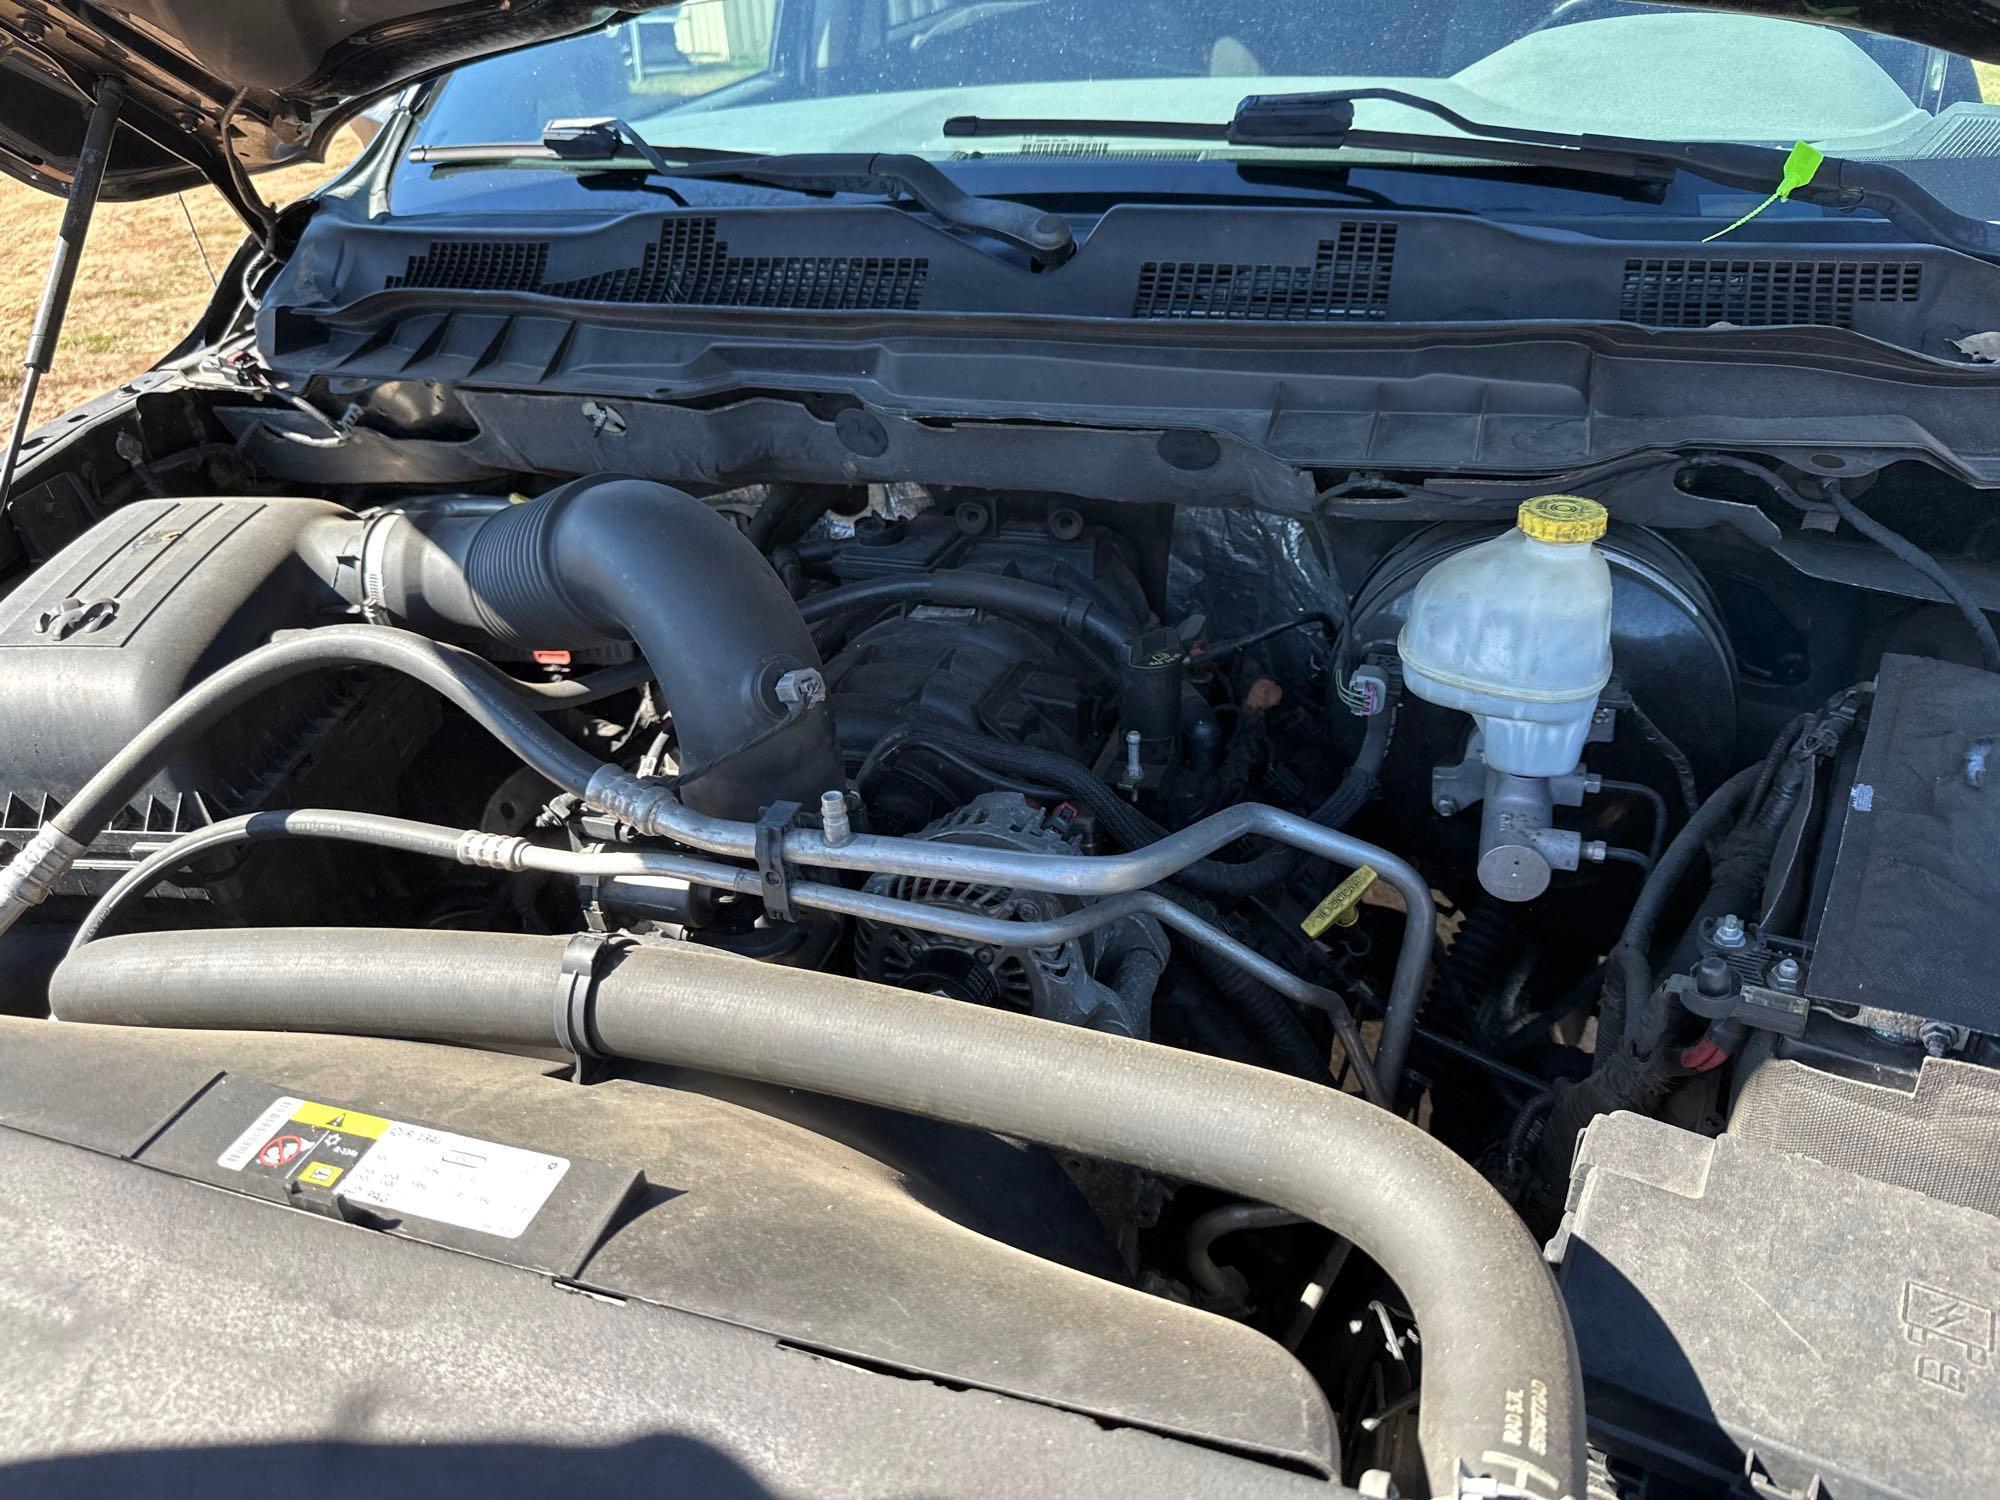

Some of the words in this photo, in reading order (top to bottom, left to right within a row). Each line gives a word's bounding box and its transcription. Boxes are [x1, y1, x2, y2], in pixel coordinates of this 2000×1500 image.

[1329, 876, 1360, 908] ENGINE
[1315, 906, 1331, 920] OIL
[1502, 1413, 1523, 1446] RAD
